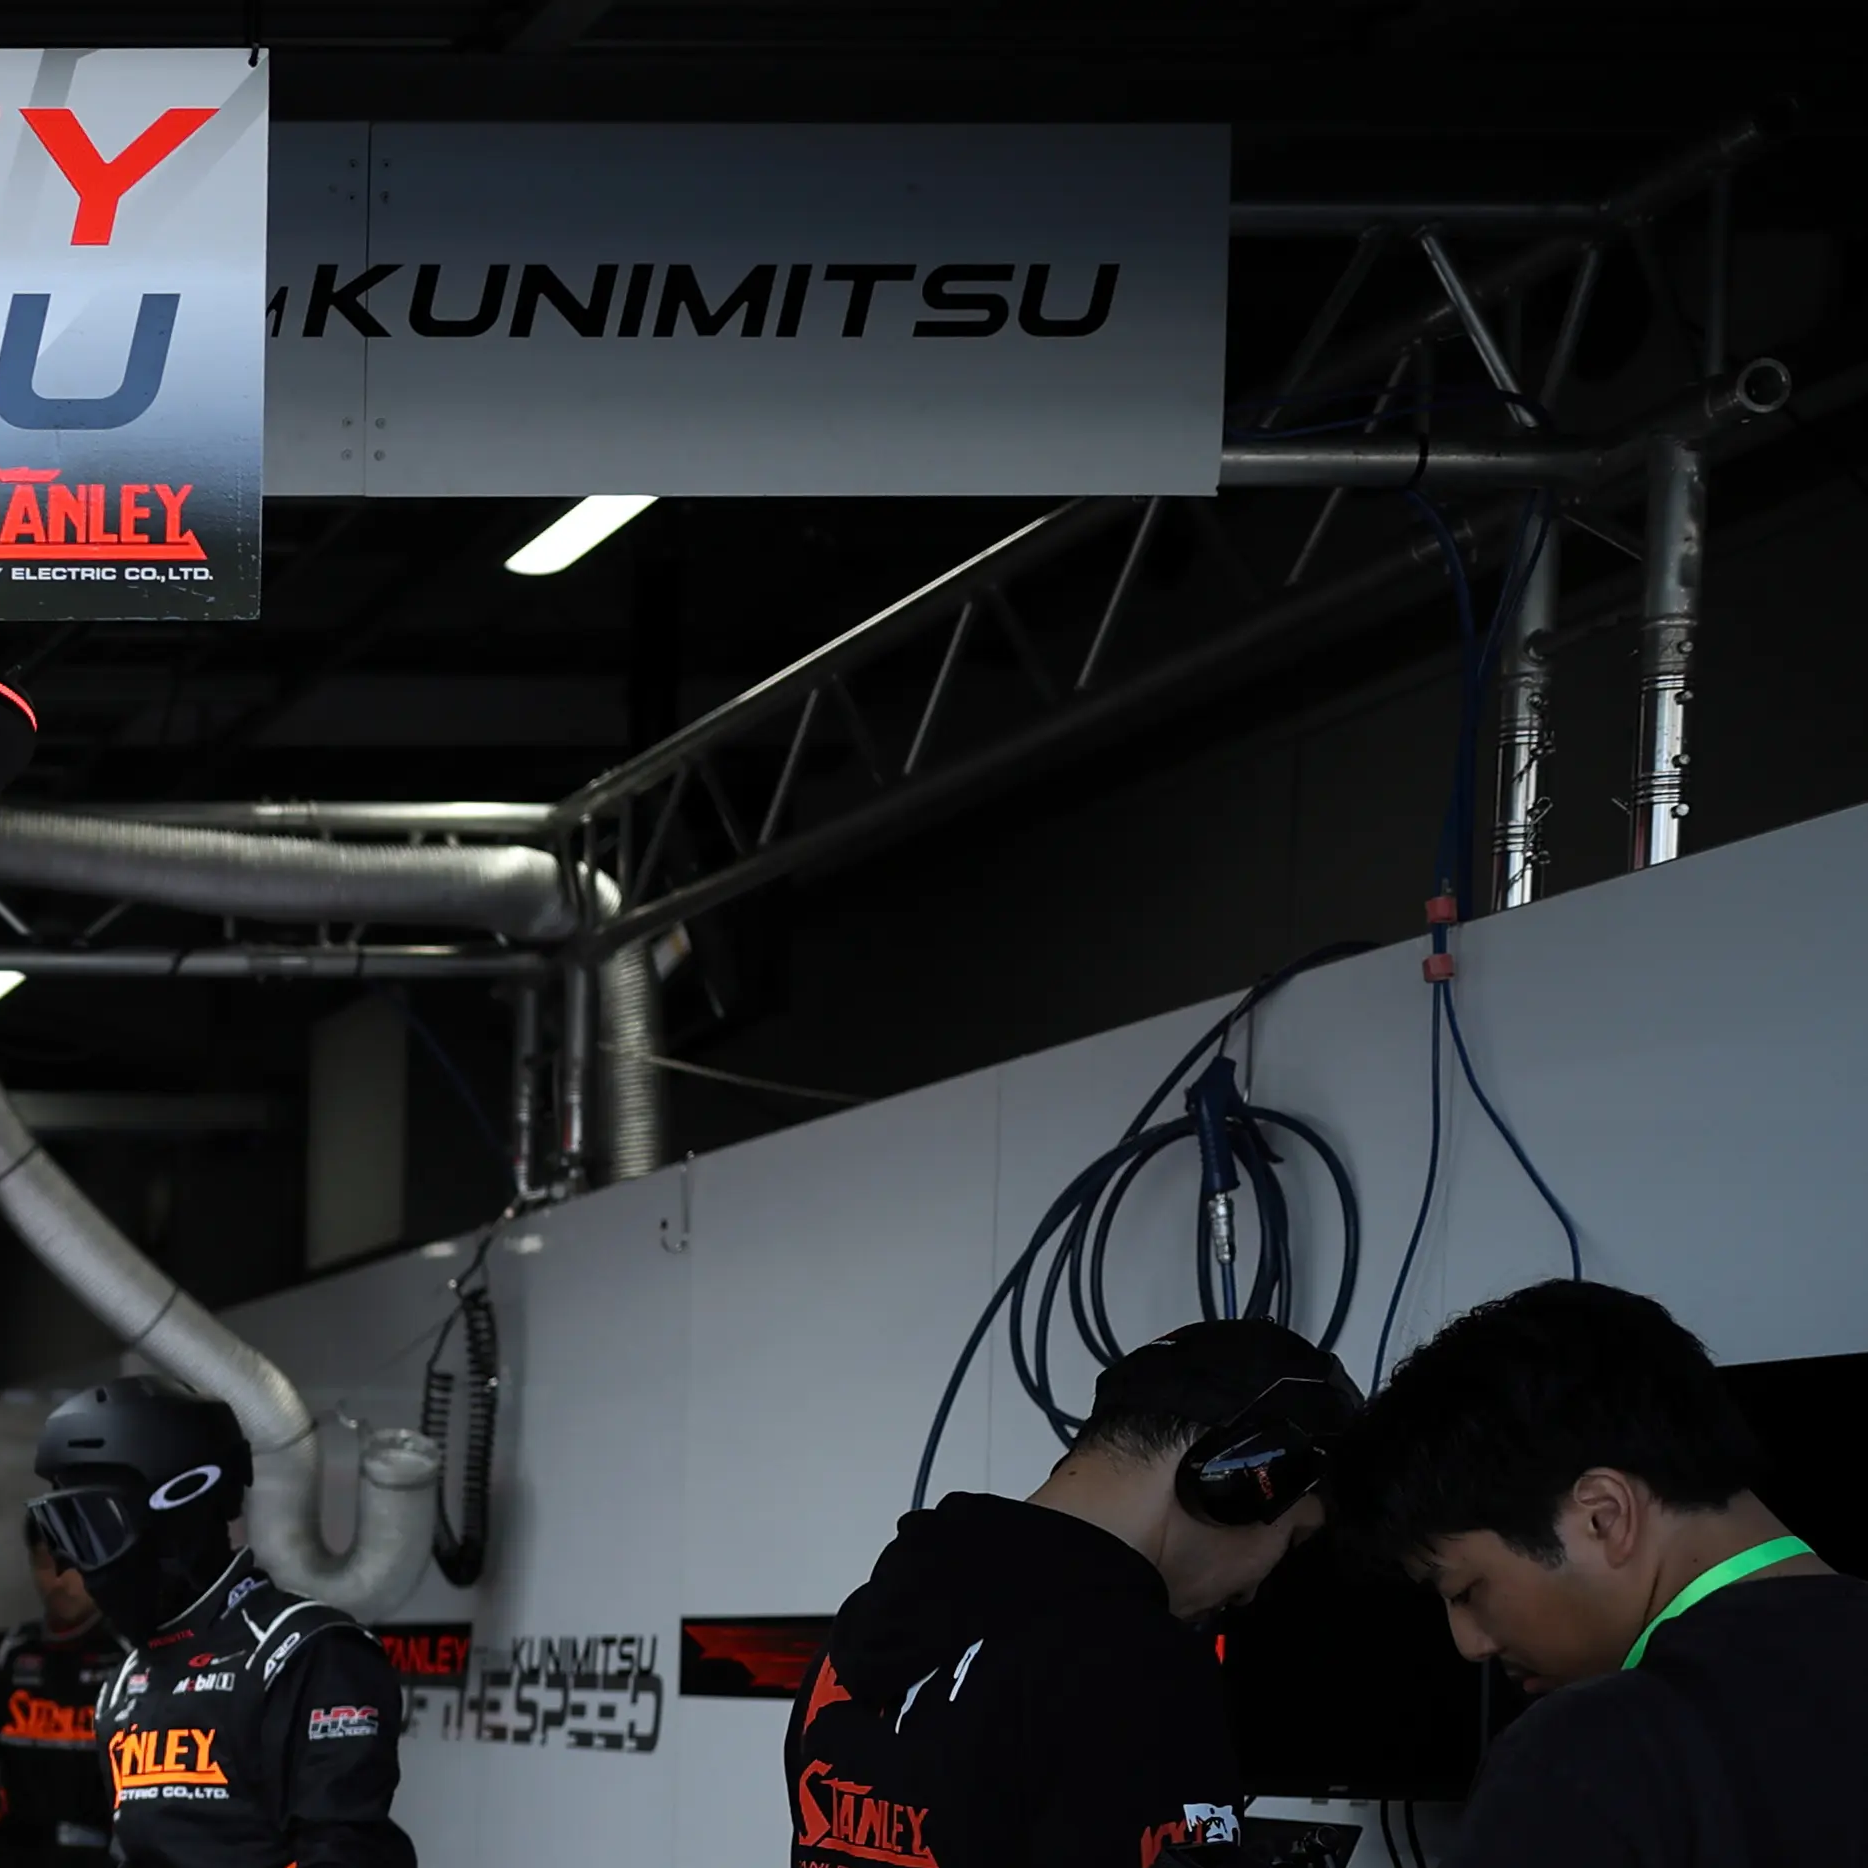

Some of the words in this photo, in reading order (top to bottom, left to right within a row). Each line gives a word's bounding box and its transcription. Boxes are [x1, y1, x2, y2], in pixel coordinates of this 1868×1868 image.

[301, 263, 1121, 339] KUNIMITSU
[10, 566, 118, 582] ELECTRIC
[383, 1635, 470, 1674] TANLEY
[511, 1634, 657, 1678] KUNIMITSU
